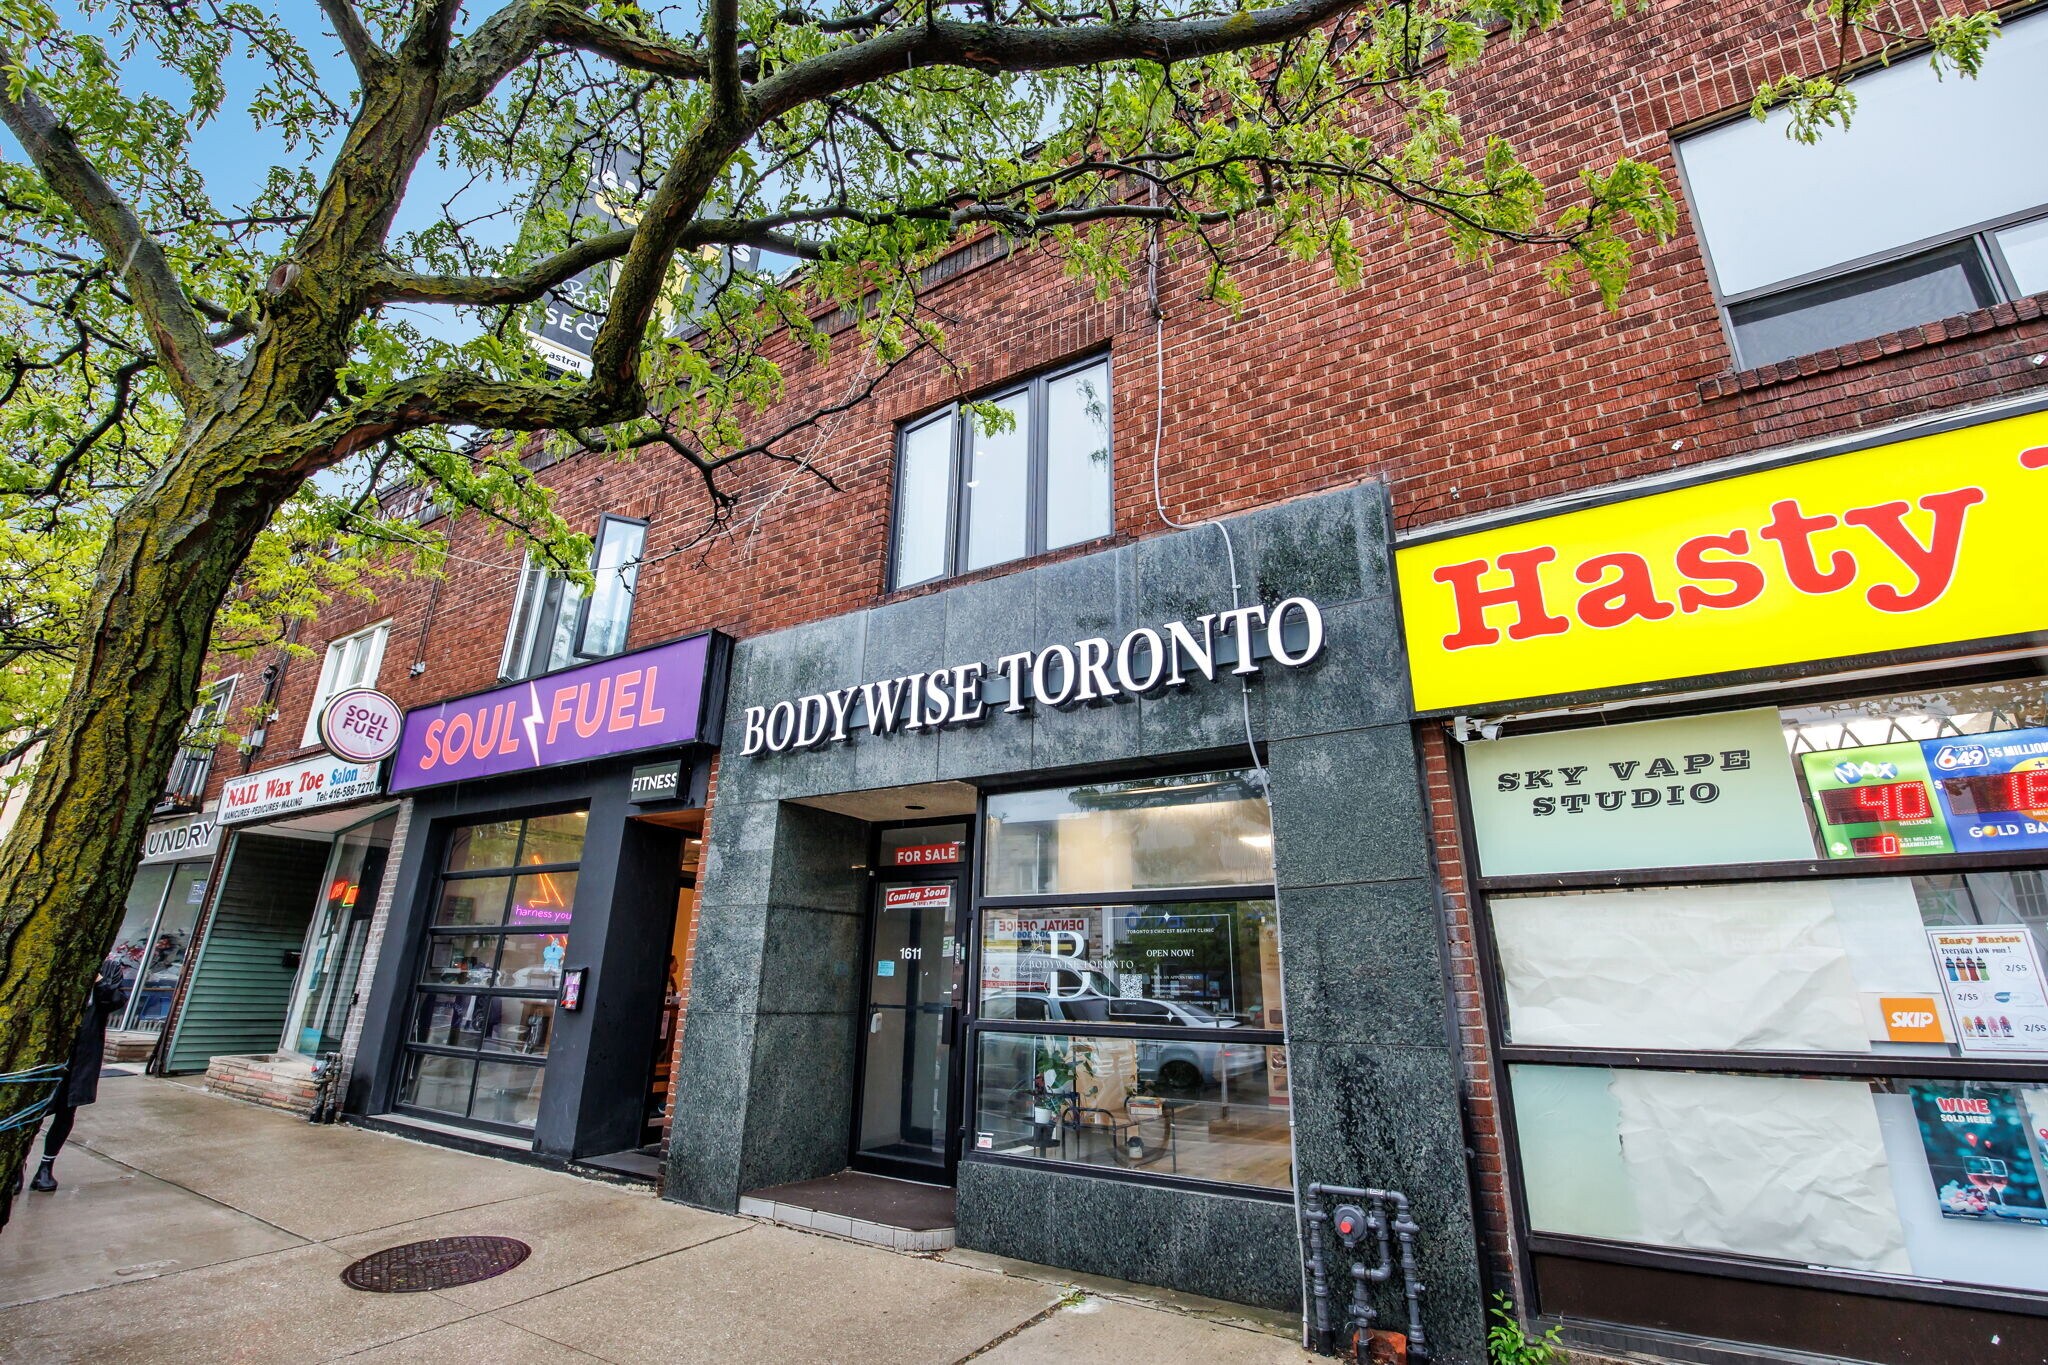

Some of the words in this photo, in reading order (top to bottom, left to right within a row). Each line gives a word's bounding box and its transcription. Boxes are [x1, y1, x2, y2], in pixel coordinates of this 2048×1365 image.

[548, 351, 581, 369] astral
[1433, 486, 1985, 651] Hasty
[739, 662, 985, 757] BODYWISE
[997, 597, 1326, 714] TORONTO
[346, 705, 389, 730] SOUL
[419, 701, 519, 770] SOUL
[546, 666, 665, 745] FUEL
[342, 717, 384, 742] FUEL
[1988, 748, 2004, 757] $5
[1498, 766, 1587, 791] SKY
[1609, 749, 1751, 780] VAPE
[1834, 761, 1896, 784] MAX
[265, 778, 295, 803] Wax
[299, 771, 325, 793] Toe
[329, 766, 359, 786] Salon
[328, 781, 375, 799] 416-588-7270
[631, 772, 678, 792] FITNESS
[1533, 782, 1720, 816] STUDIO
[1860, 782, 1926, 819] 40
[145, 820, 216, 857] UNDRY
[897, 851, 921, 863] FOR
[925, 847, 956, 860] SALE
[888, 890, 921, 902] Coming
[924, 888, 947, 898] Soon
[515, 905, 552, 919] harness
[1938, 937, 1973, 946] Hasty
[1976, 936, 2021, 944] Market
[900, 948, 922, 960] 1611
[1146, 949, 1169, 957] OPEN
[1171, 949, 1195, 957] NOW!
[1941, 947, 1973, 955] Everyday
[1049, 930, 1091, 999] B
[1083, 959, 1134, 969] TORONTO
[2005, 964, 2028, 972] 2/$5
[1957, 993, 1979, 1001] 2/$5
[1890, 1011, 1934, 1028] SKIP
[2023, 1024, 2047, 1032] 2/$5
[1937, 1097, 1991, 1115] WINE
[1940, 1114, 1965, 1123] SOLD
[1966, 1115, 1993, 1124] HERE
